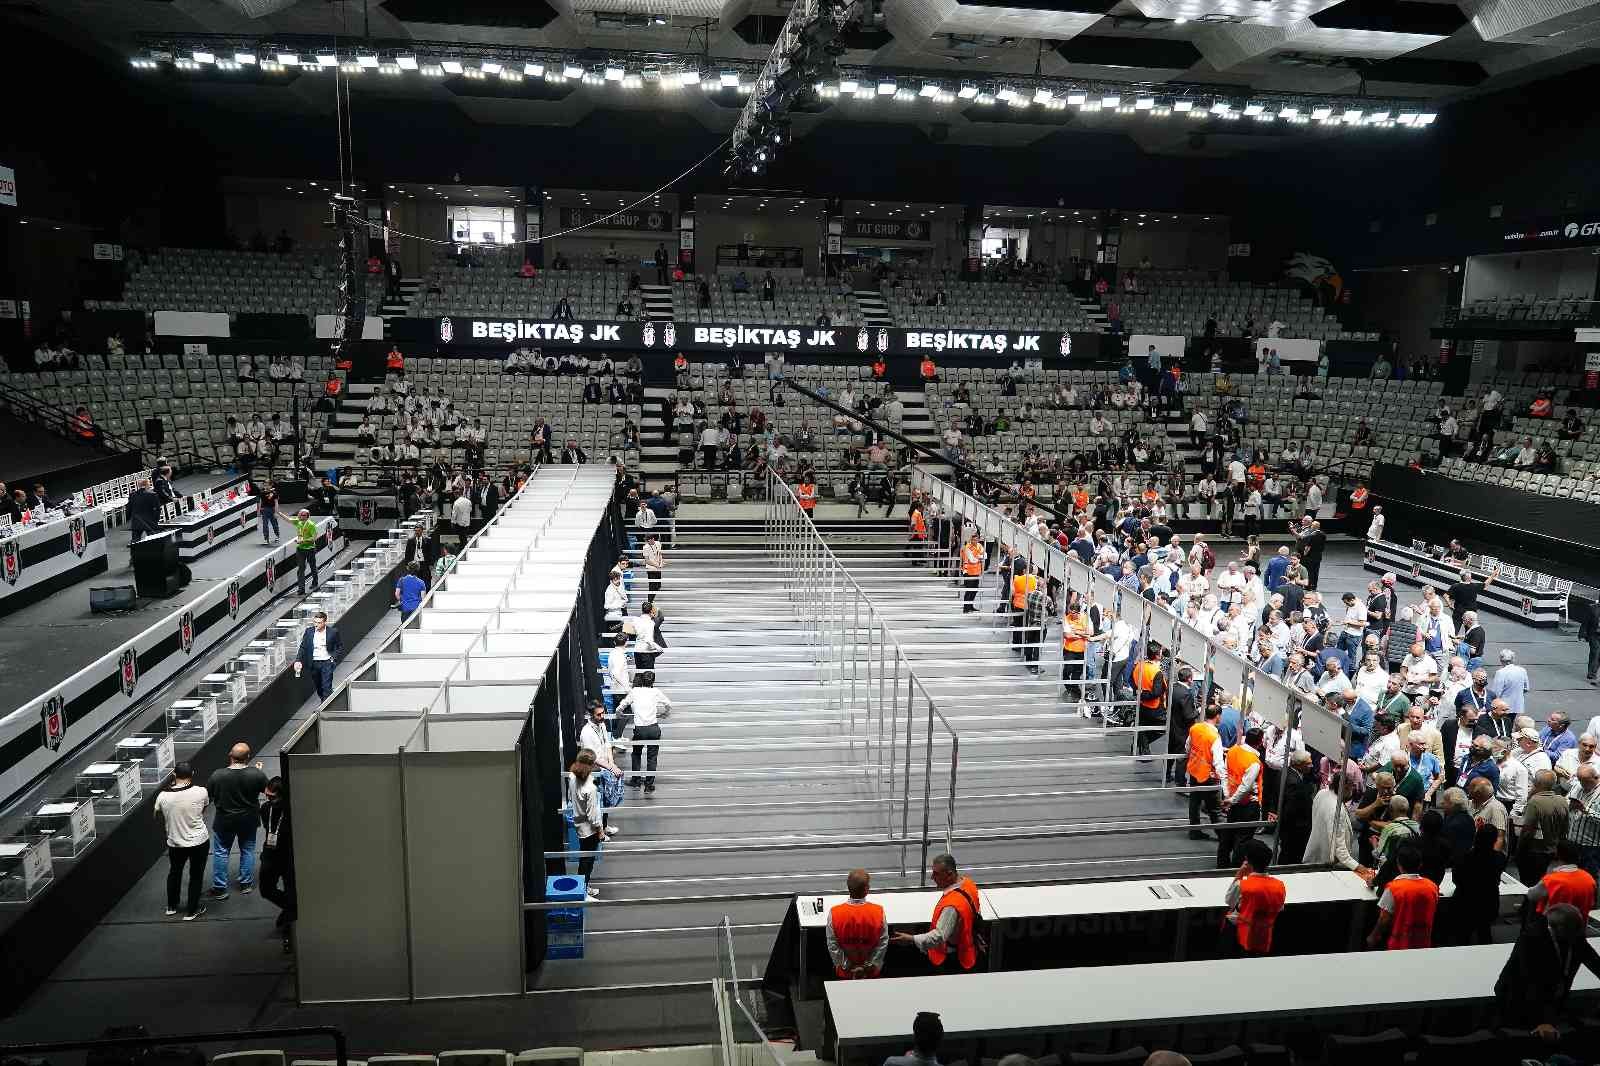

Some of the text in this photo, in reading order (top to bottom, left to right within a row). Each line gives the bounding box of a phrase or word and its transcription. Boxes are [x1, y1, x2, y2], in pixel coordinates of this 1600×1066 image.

[613, 214, 640, 225] GRUP
[472, 320, 620, 343] BEŞİKTAŞ JK
[694, 325, 835, 348] BEŞİKTAŞ JK
[906, 331, 1040, 353] BEŞİKTAŞ JK
